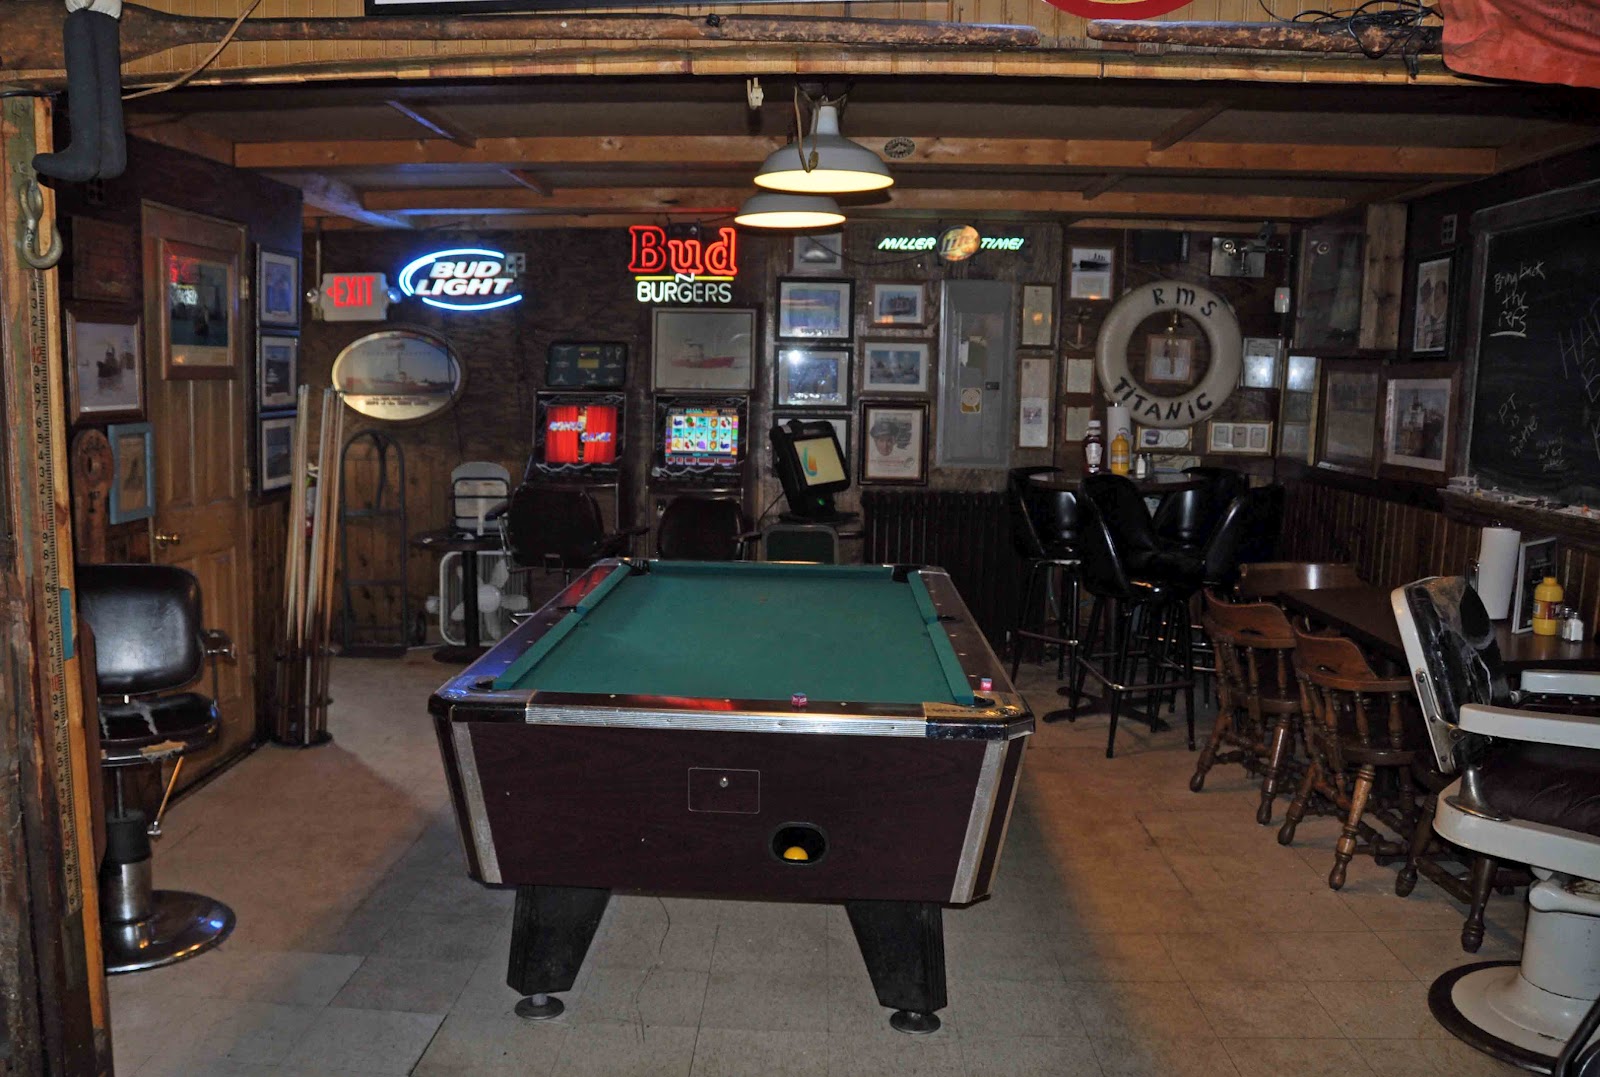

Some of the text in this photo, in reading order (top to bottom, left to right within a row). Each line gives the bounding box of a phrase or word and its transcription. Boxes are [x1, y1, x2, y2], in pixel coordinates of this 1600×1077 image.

[628, 225, 738, 276] Bud
[877, 237, 937, 250] MILLER
[980, 237, 1025, 250] TIME!
[429, 261, 502, 278] BUD
[333, 276, 375, 308] EXIT
[413, 278, 514, 296] LIGHT
[637, 281, 732, 303] BURGERS
[580, 431, 613, 442] GAME
